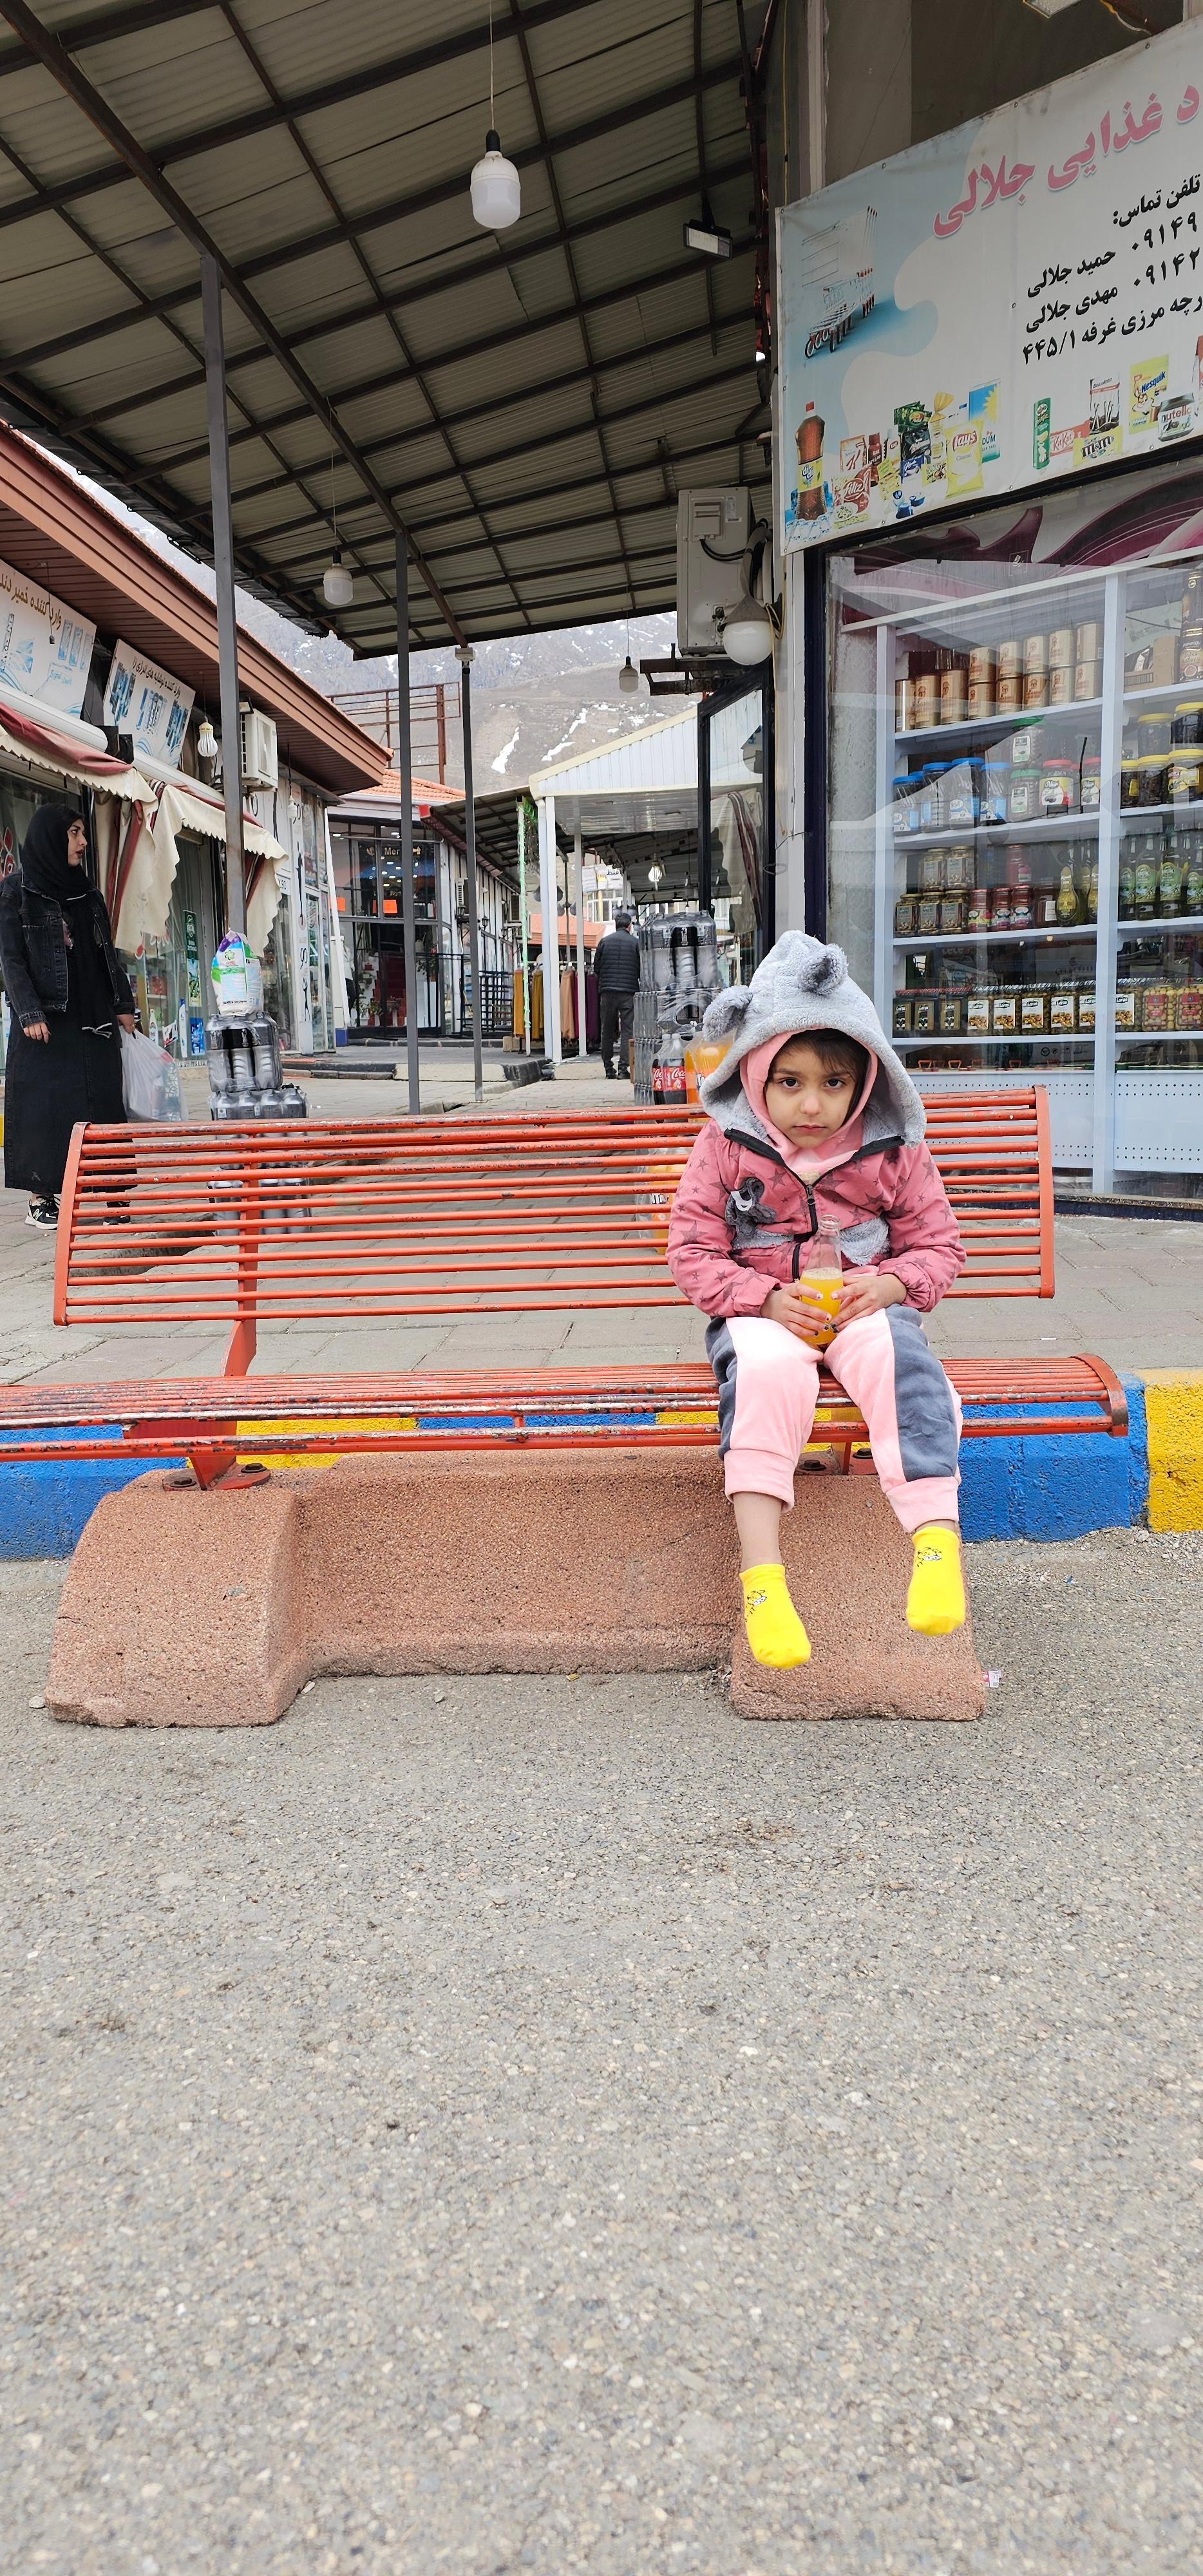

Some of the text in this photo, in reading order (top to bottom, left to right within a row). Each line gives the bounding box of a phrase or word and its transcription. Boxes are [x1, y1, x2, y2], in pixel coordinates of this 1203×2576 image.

[1048, 93, 1163, 189] غذایی
[934, 155, 1036, 237] جلالی
[1113, 174, 1200, 227] تلفن تماس:
[1077, 251, 1117, 275] حمید
[1027, 264, 1072, 298] جلالی
[1026, 300, 1071, 333] جلالی
[1075, 287, 1118, 316] مهدی
[1081, 317, 1117, 345] غرفه
[1121, 306, 1165, 336] مرزی
[1141, 370, 1166, 393] Nesquik
[11, 587, 28, 604] خمیر
